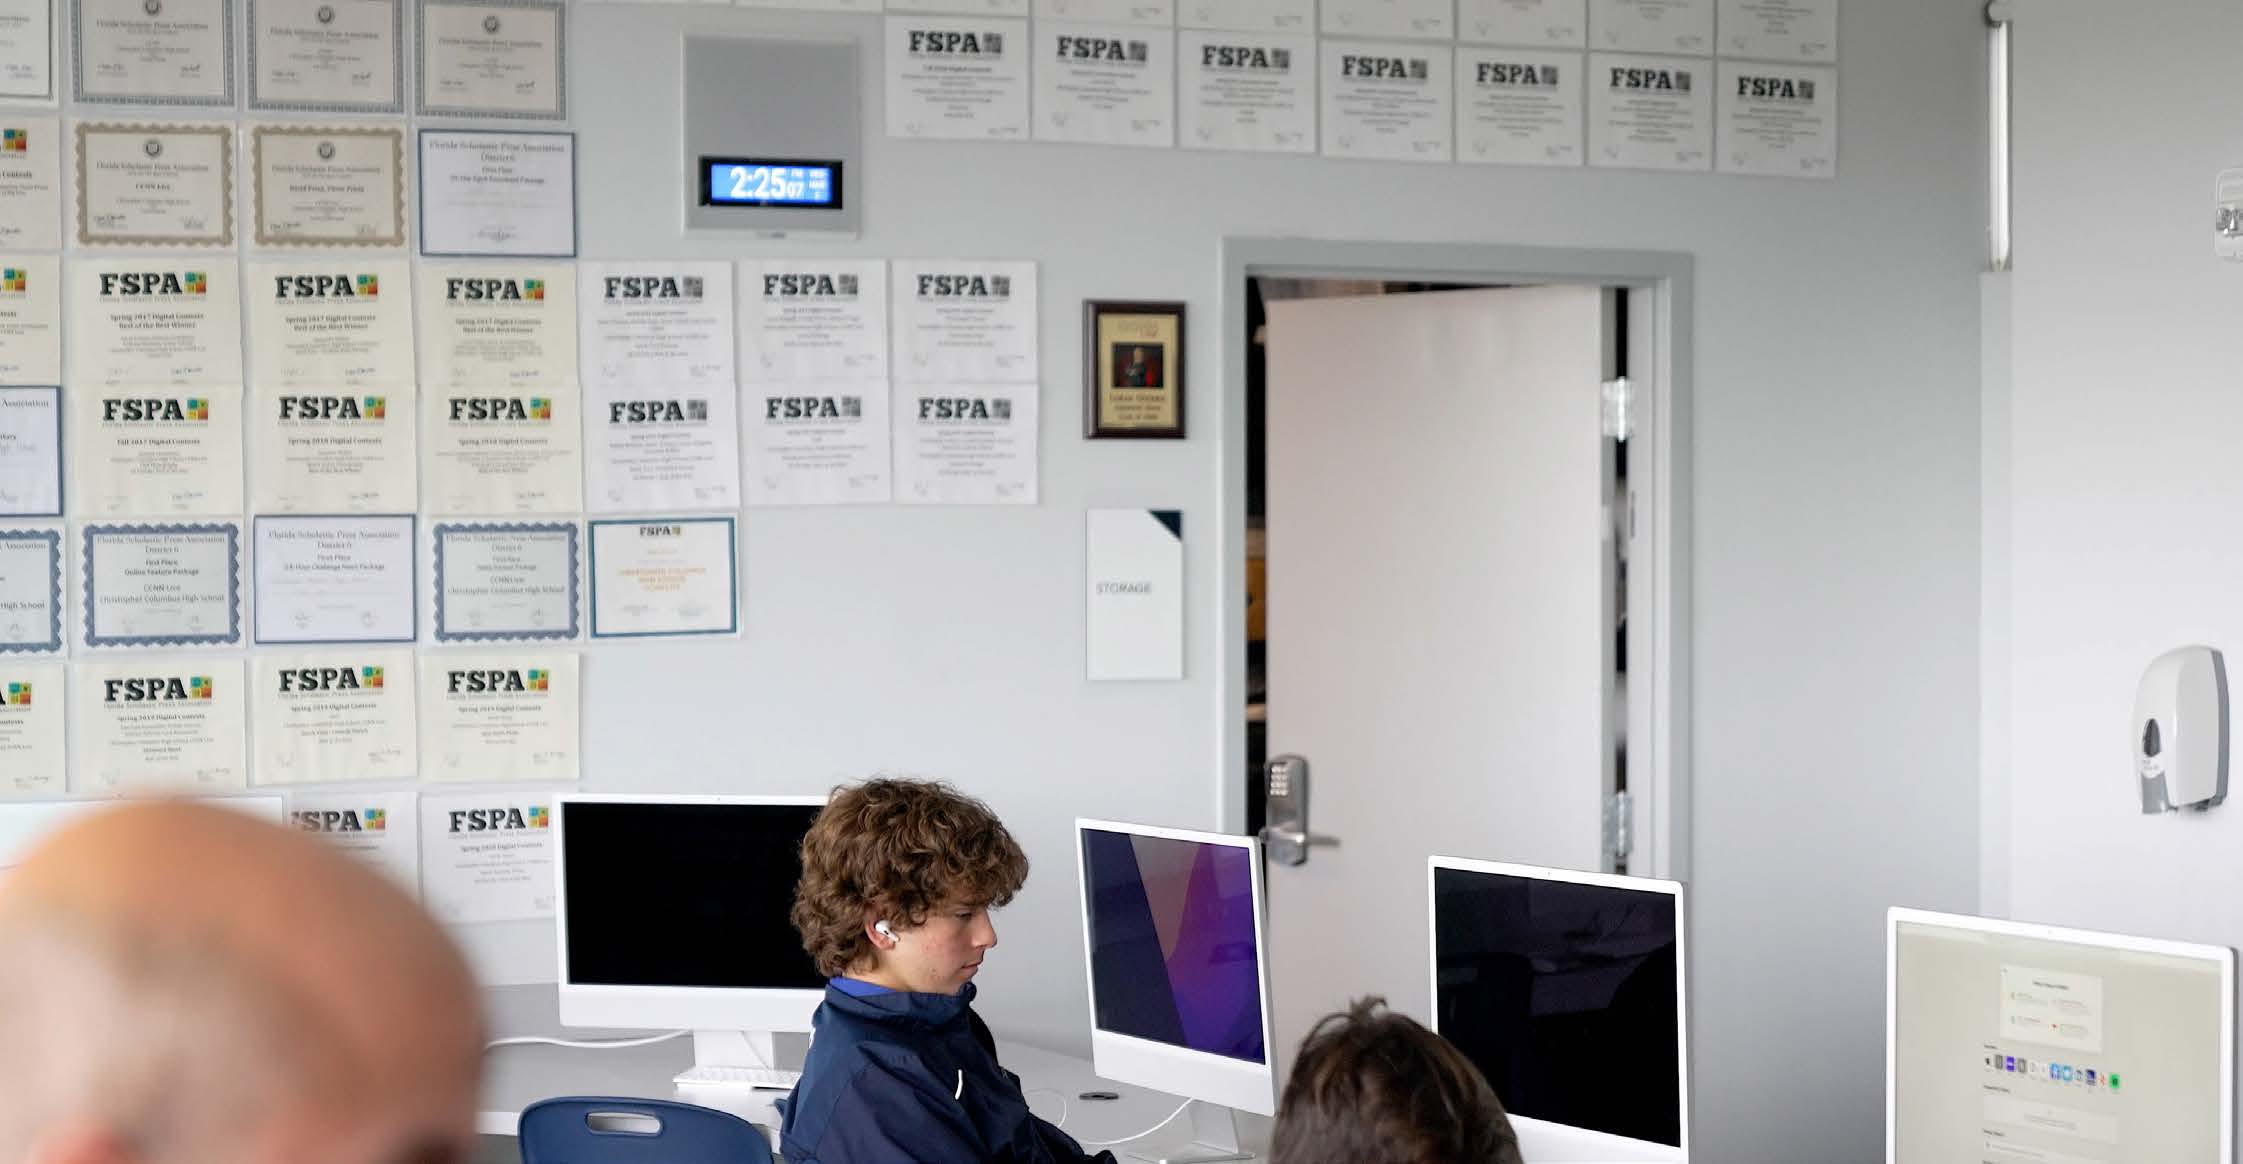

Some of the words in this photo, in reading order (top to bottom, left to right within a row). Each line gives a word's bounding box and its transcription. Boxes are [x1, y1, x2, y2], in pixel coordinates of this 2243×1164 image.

[909, 31, 980, 53] FSPA
[1057, 36, 1126, 60] FSPA
[1202, 44, 1268, 68] FSPA
[1342, 55, 1407, 78] FSPA
[1477, 62, 1538, 85] FSPA
[1610, 67, 1672, 90] FSPA
[1737, 76, 1795, 99] FSPA
[730, 166, 786, 198] 2:25
[787, 182, 804, 198] 07
[100, 272, 182, 295] FSPA
[275, 275, 354, 298] FSPA
[446, 278, 521, 300] FSPA
[604, 276, 680, 298] FSPA
[763, 274, 836, 296] FSPA
[917, 274, 988, 296] FSPA
[102, 399, 184, 420] FSPA
[278, 396, 361, 419] FSPA
[449, 397, 527, 420] FSPA
[609, 400, 684, 424] FSPA
[766, 397, 839, 418] FSPA
[918, 398, 989, 418] FSPA
[640, 526, 671, 536] FSPA
[1096, 582, 1151, 594] STORAGE
[104, 677, 188, 702] FSPA
[279, 667, 360, 692] FSPA
[448, 670, 525, 693] FSPA
[448, 807, 526, 832] FSPA
